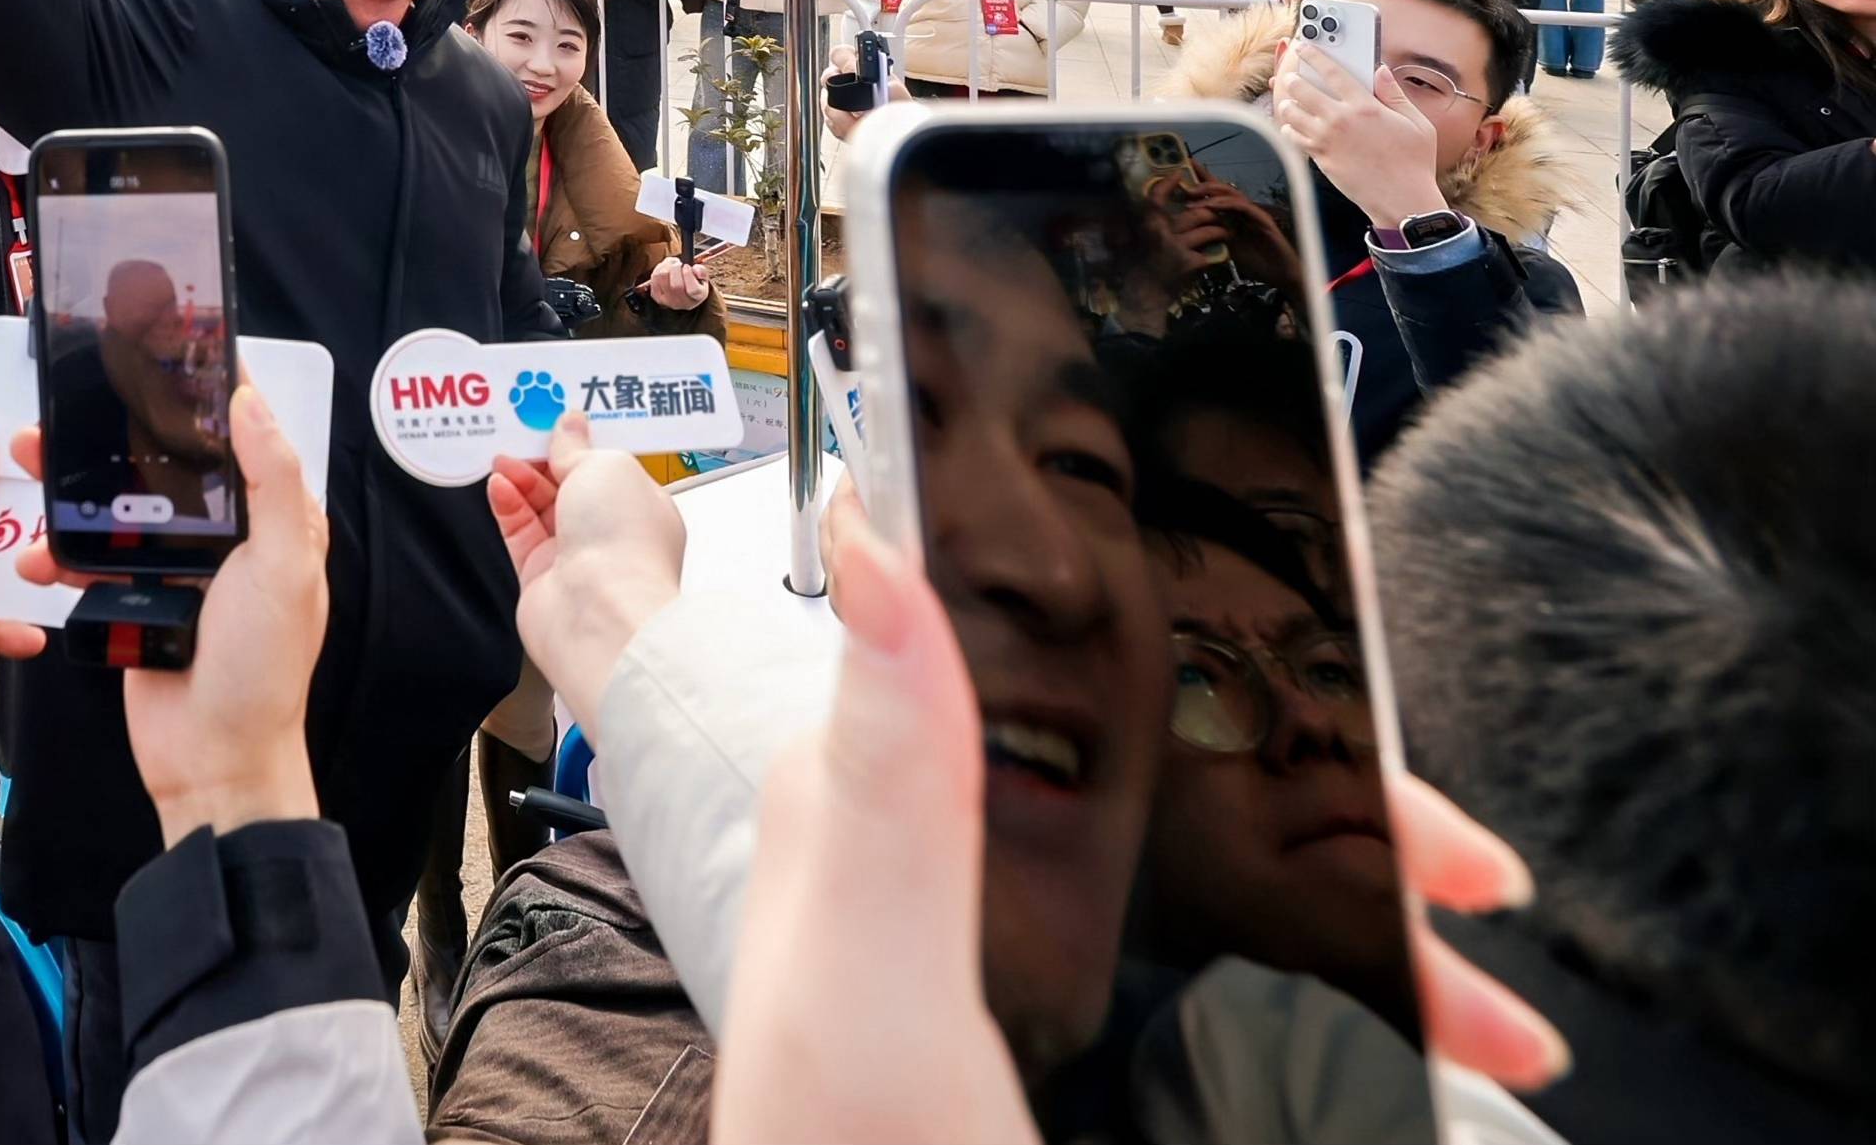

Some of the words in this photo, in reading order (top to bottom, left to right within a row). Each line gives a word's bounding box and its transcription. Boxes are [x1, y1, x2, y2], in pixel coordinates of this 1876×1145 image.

[390, 372, 491, 410] HMG
[580, 373, 716, 416] 大象新闻
[397, 431, 428, 440] HENAN
[433, 429, 462, 438] MEDIA
[467, 427, 497, 436] GROUP
